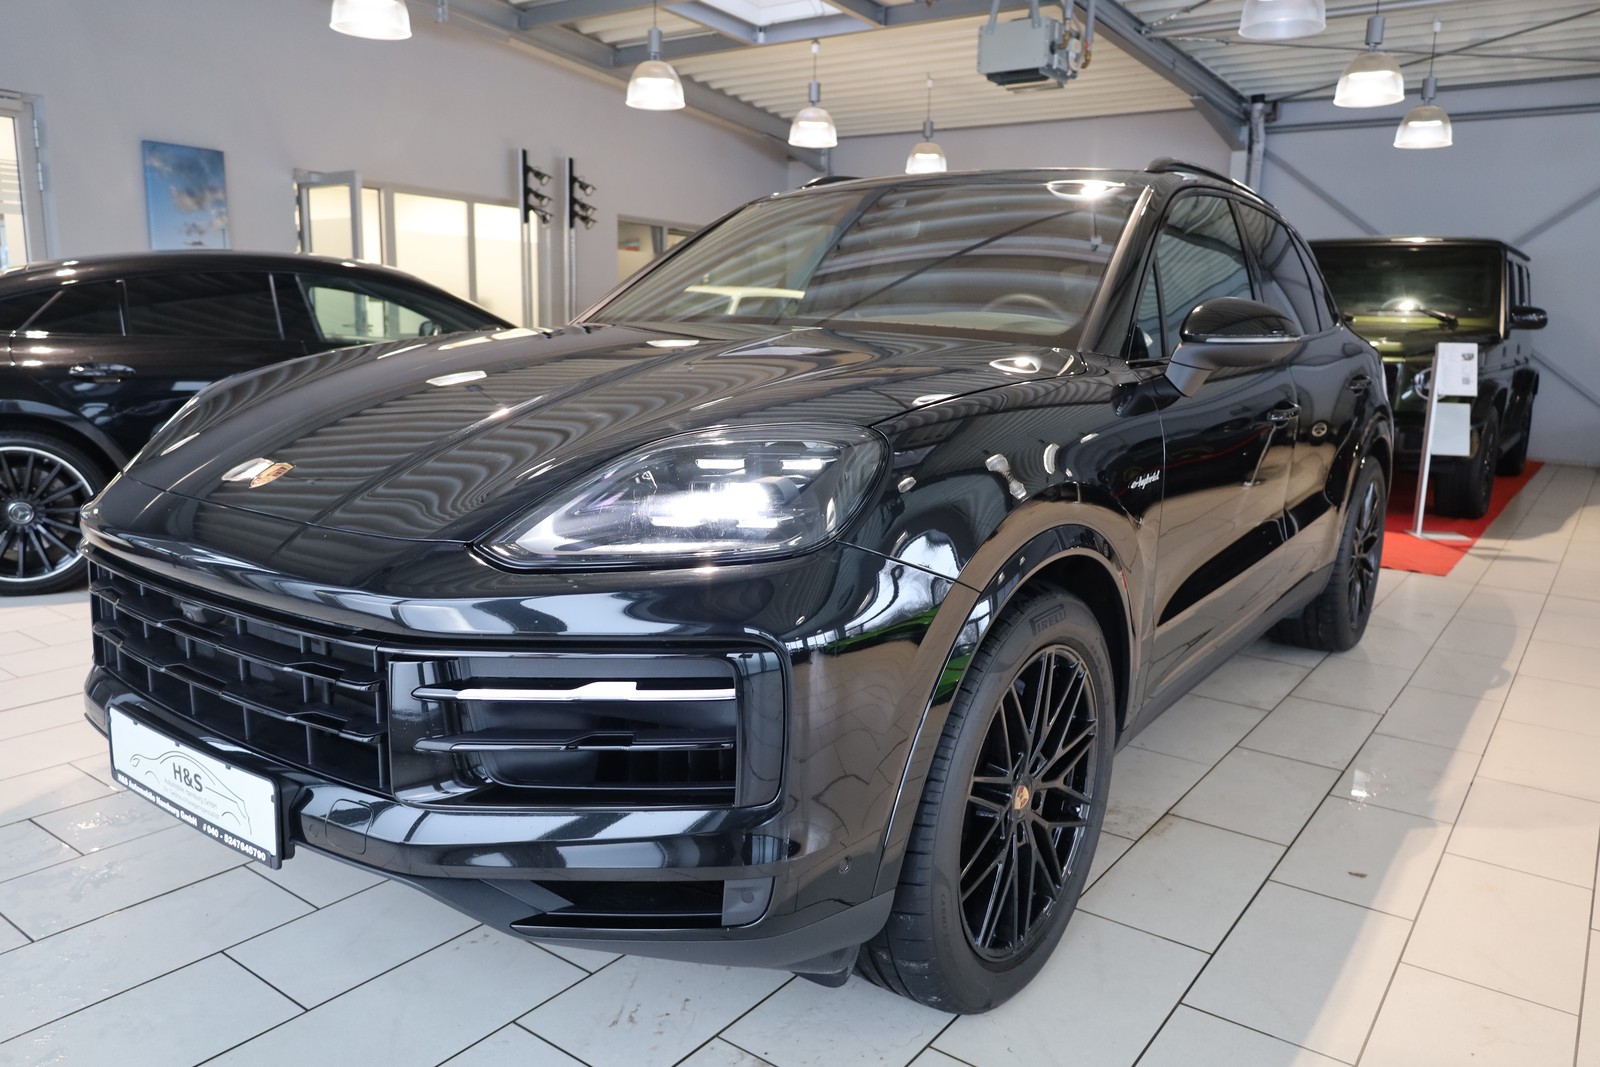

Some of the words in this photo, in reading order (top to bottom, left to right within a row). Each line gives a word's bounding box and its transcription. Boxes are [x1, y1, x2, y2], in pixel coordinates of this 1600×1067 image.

[1029, 602, 1067, 636] PIRELLI
[172, 762, 203, 792] H&S
[207, 824, 219, 838] 040
